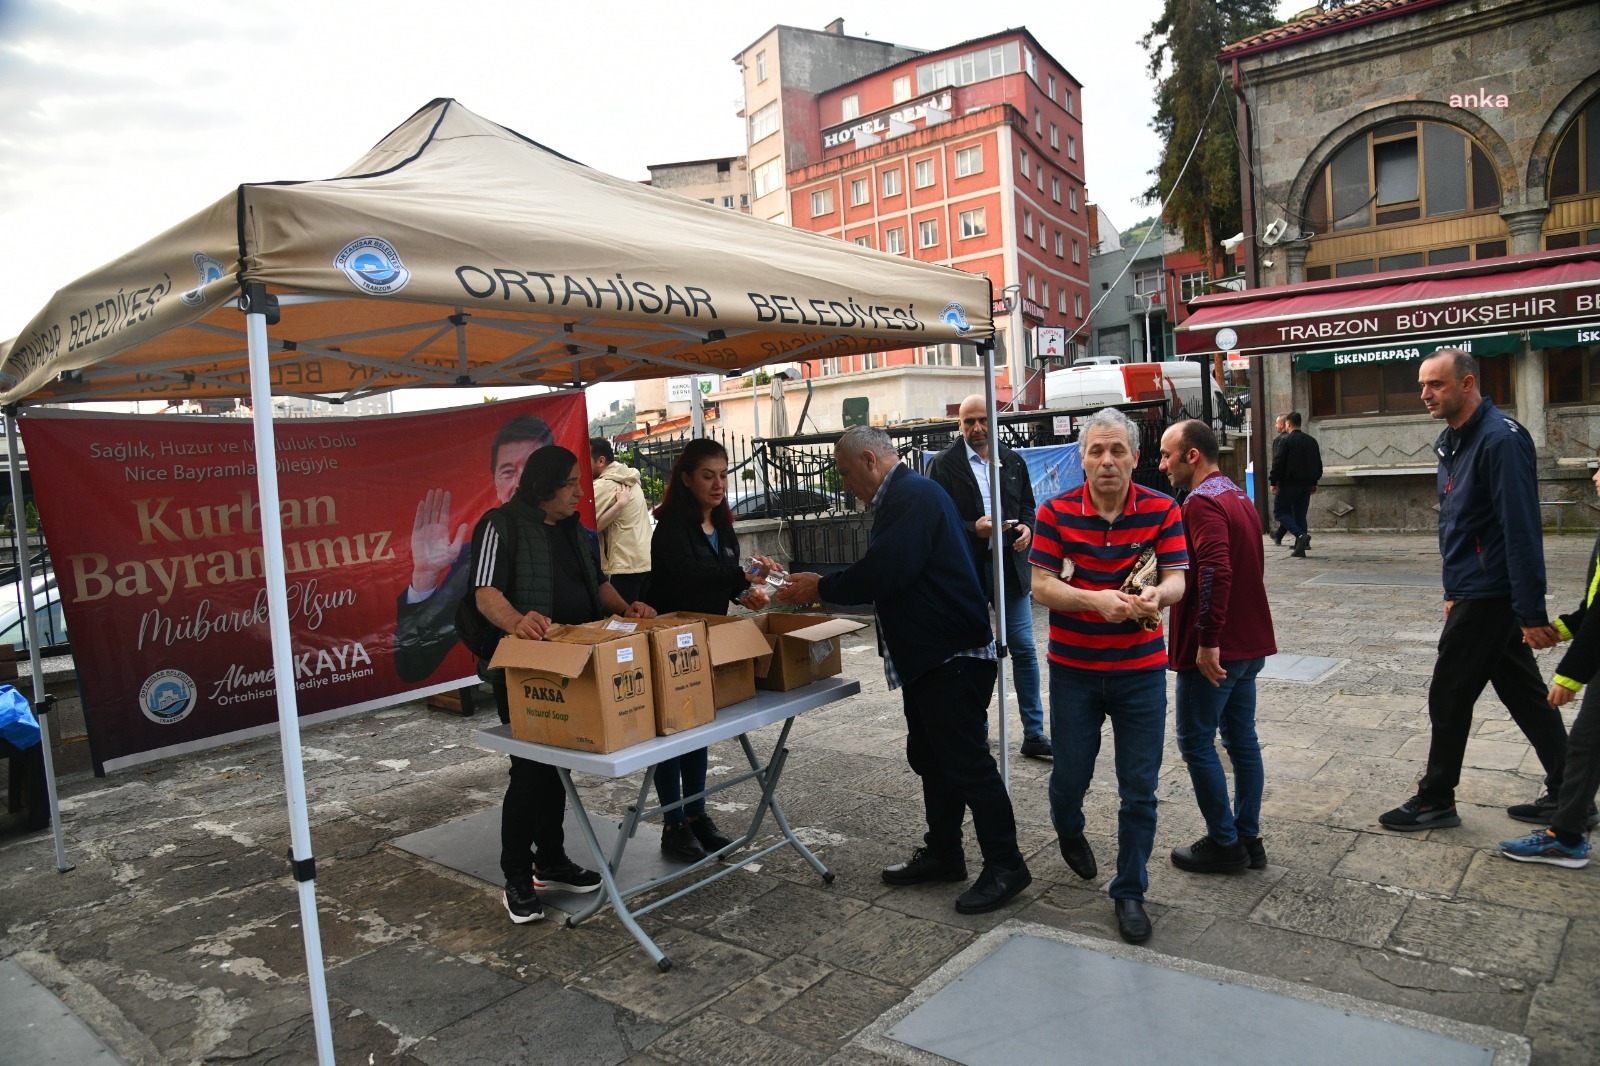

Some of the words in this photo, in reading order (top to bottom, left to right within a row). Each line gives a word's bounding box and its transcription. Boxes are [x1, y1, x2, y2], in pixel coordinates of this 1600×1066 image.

[824, 118, 885, 148] HOTEL
[373, 240, 401, 270] BELEDİYES
[362, 282, 392, 292] TRABZON
[455, 265, 718, 319] ORTAHİSAR
[747, 292, 925, 331] BELEDİYESİ
[69, 272, 172, 352] BELEDİYESİ
[1277, 317, 1379, 341] TRABZON
[1396, 297, 1557, 330] BÜYÜKŞEHİR
[1334, 347, 1420, 366] İSKENDERPAŞA
[90, 441, 155, 461] Sağlık,
[160, 441, 213, 456] Huzur
[219, 442, 239, 453] ve
[243, 437, 317, 453] Mluluk
[320, 435, 357, 449] Dolu
[125, 466, 167, 481] Nice
[173, 460, 256, 482] Bayramla
[131, 489, 340, 545] Kurban
[138, 588, 269, 651] Mübarek
[208, 663, 275, 700] Ahme
[293, 642, 372, 680] KAYA
[217, 687, 277, 706] Ortahisar
[295, 677, 329, 691] lediye
[331, 668, 374, 684] Başkanı
[524, 685, 566, 703] PAKSA
[526, 706, 551, 718] Natural
[552, 710, 569, 722] Soap
